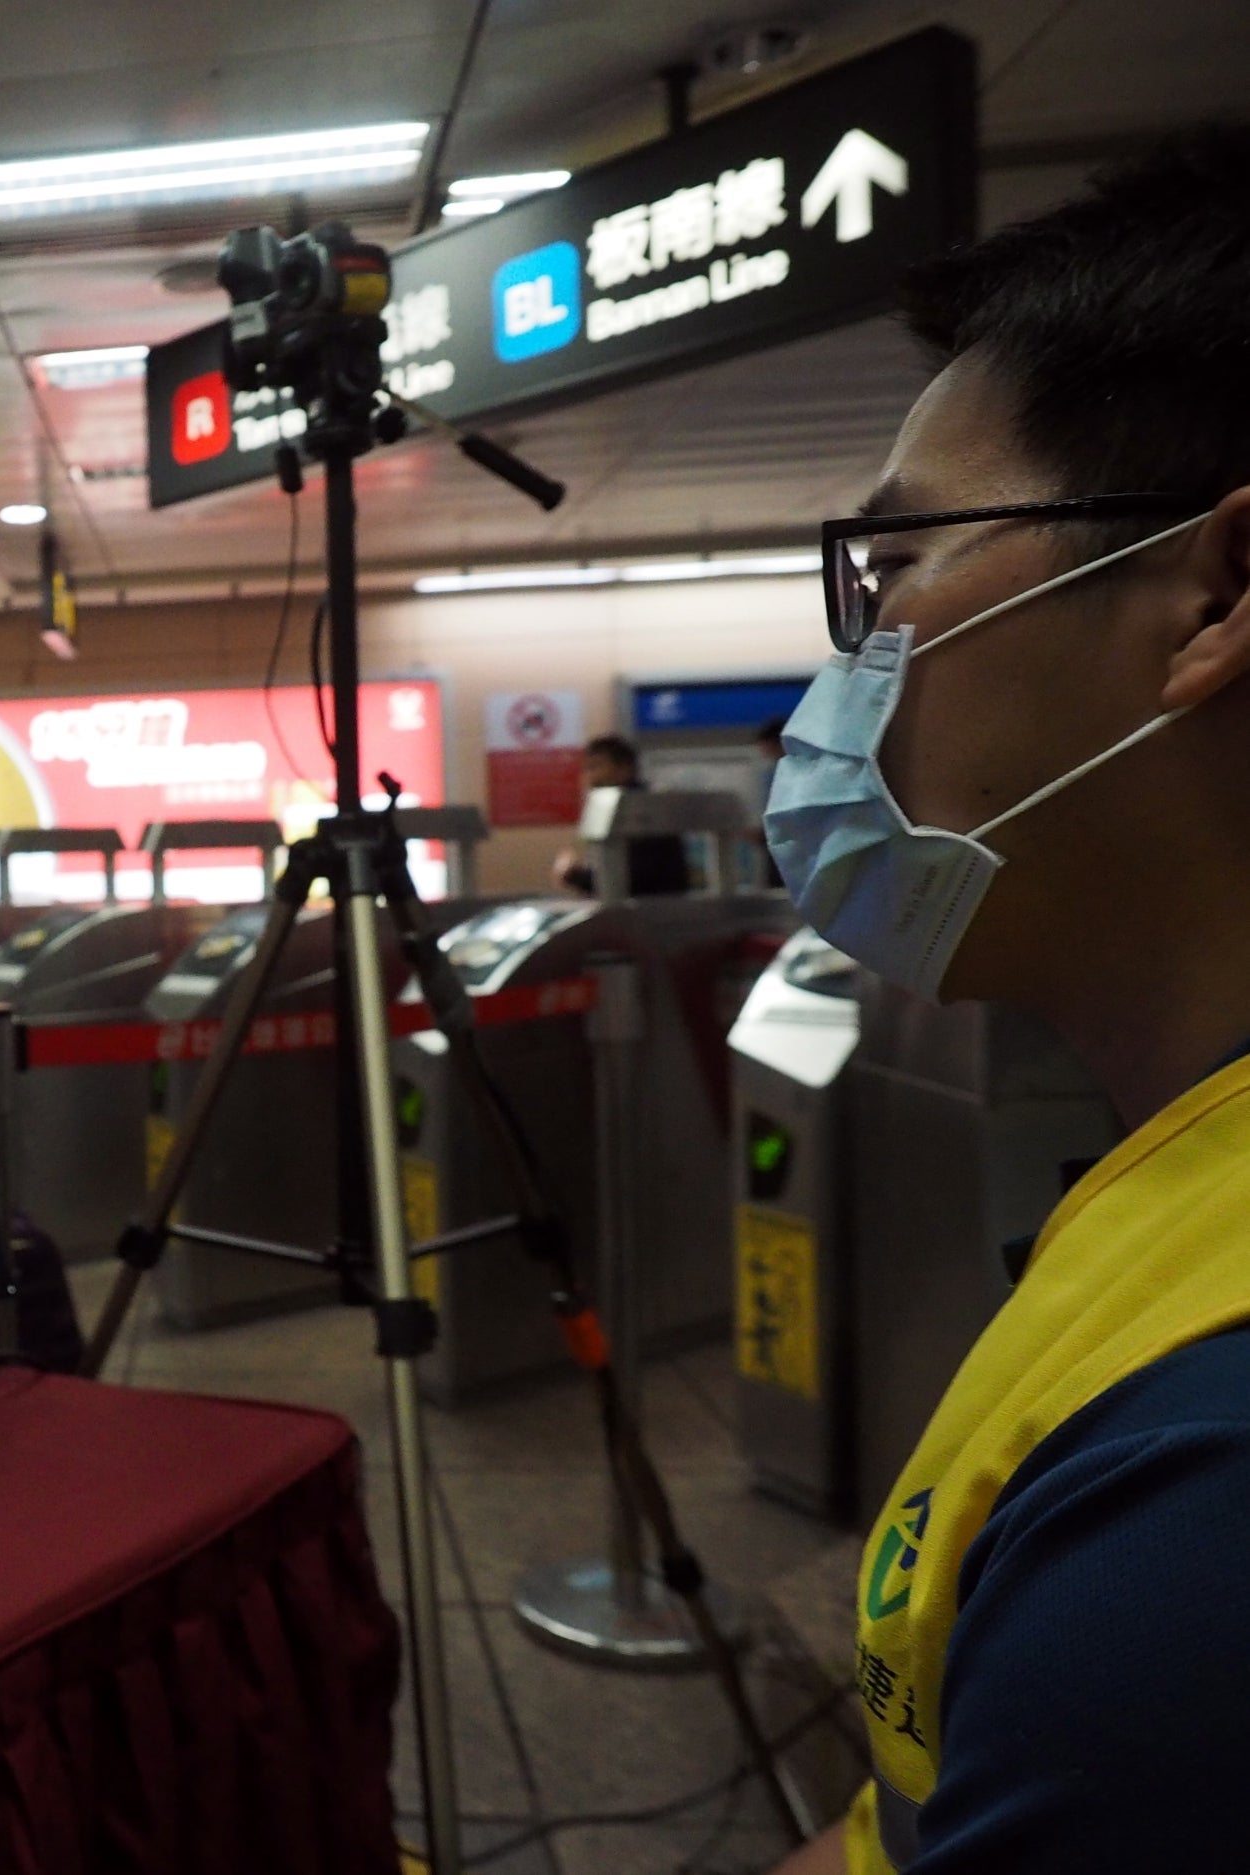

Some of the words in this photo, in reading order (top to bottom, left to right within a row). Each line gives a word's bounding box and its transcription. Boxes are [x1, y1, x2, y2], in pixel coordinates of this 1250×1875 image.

[586, 157, 788, 288] 板南線
[709, 249, 790, 303] Line
[504, 275, 569, 337] BL
[186, 397, 215, 441] R
